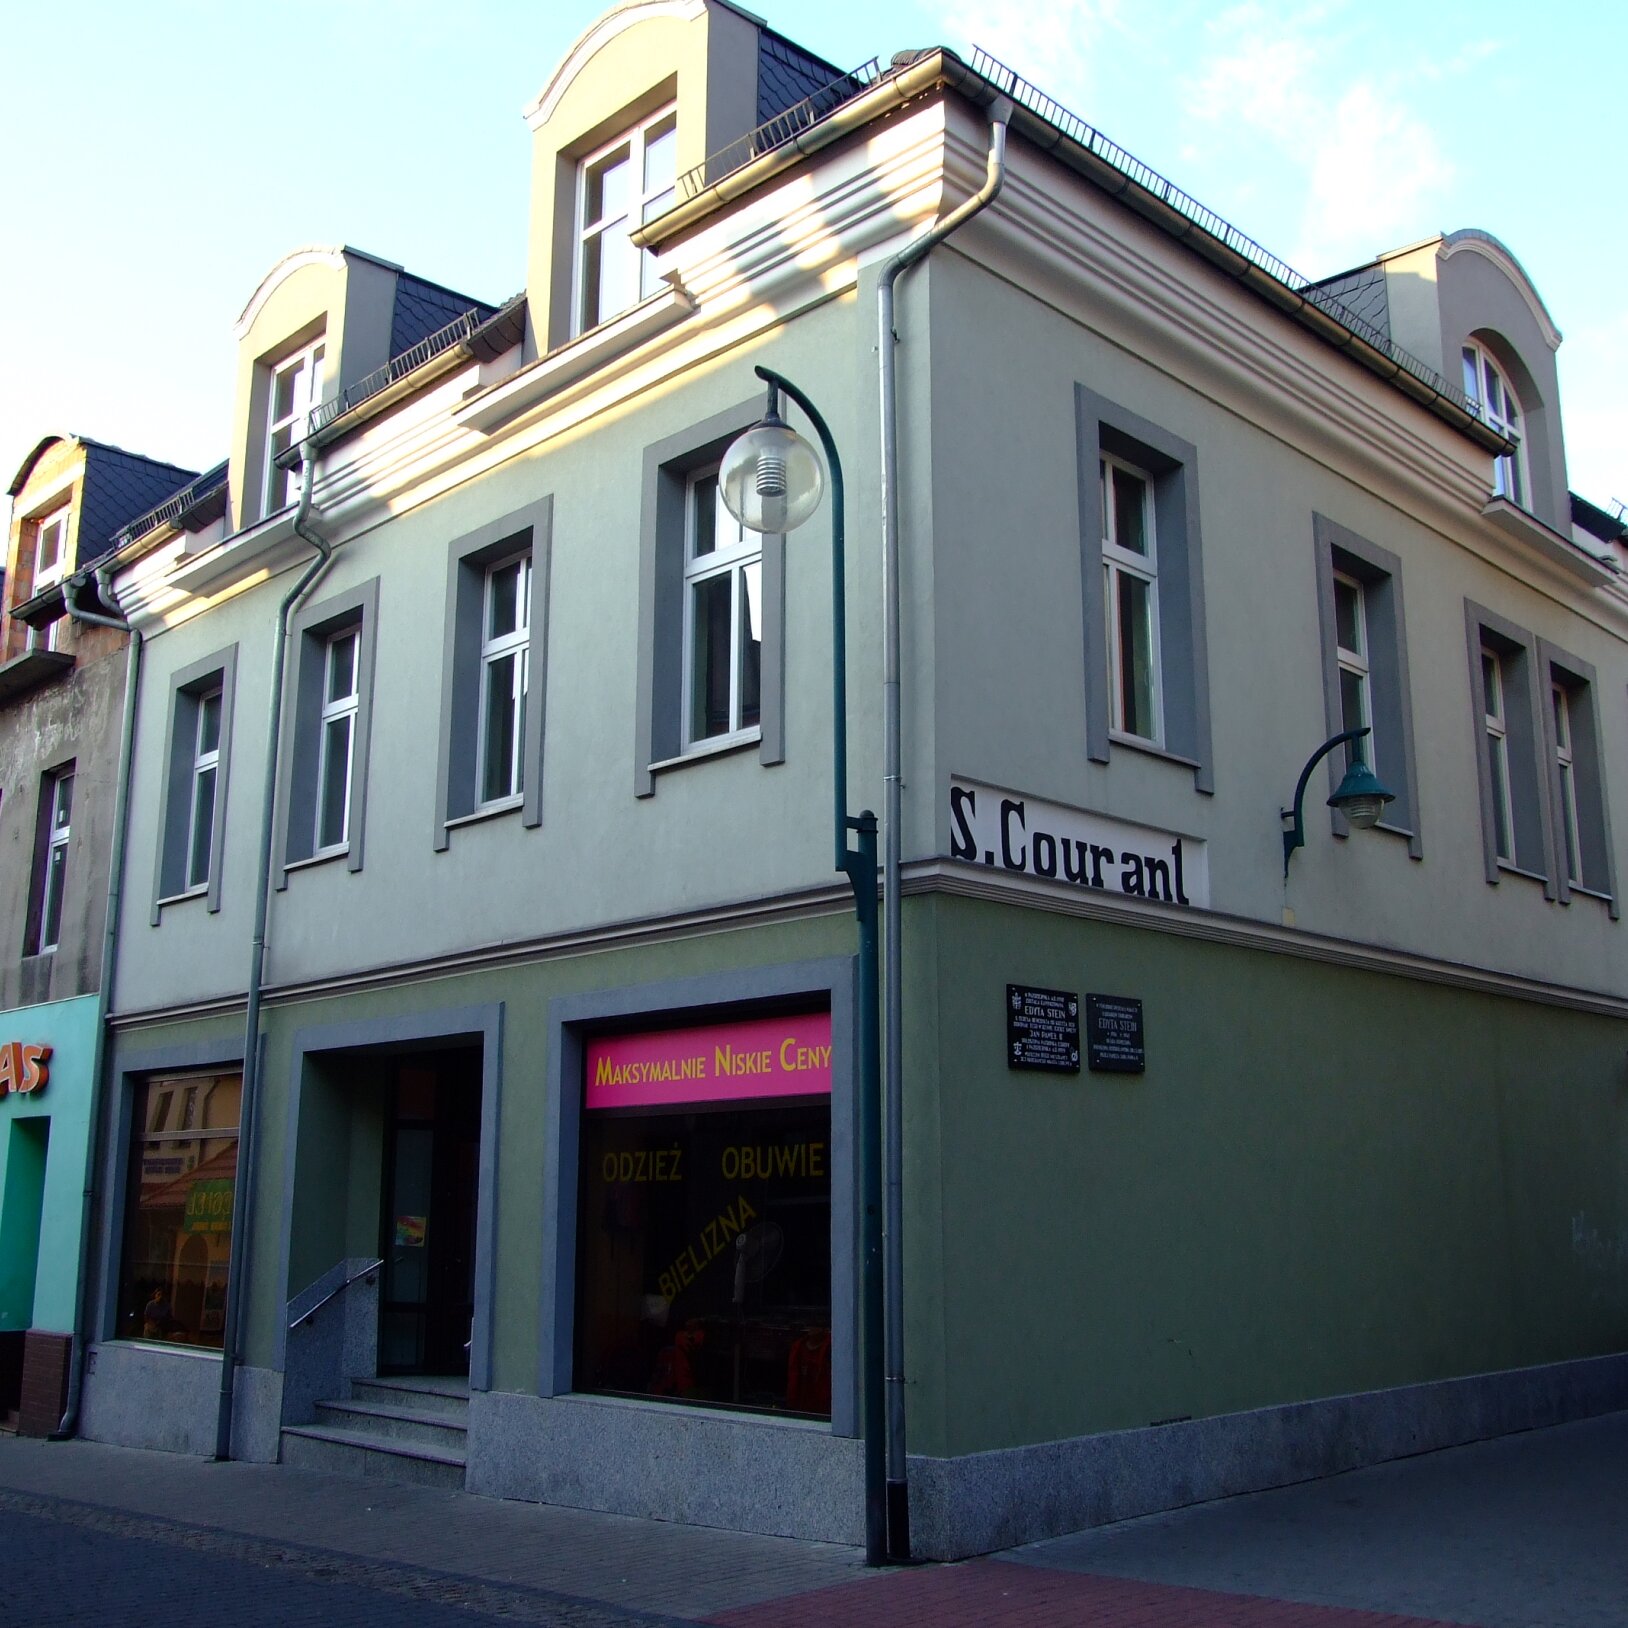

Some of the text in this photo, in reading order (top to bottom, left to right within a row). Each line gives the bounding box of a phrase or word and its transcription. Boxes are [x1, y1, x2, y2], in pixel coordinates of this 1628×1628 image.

[1024, 1005, 1066, 1019] EDYTA STEIN
[1098, 1017, 1137, 1032] EDYTA STEIN
[602, 1141, 825, 1184] ODZIEŻ OBUWIE
[657, 1193, 760, 1305] BIELIZNA
